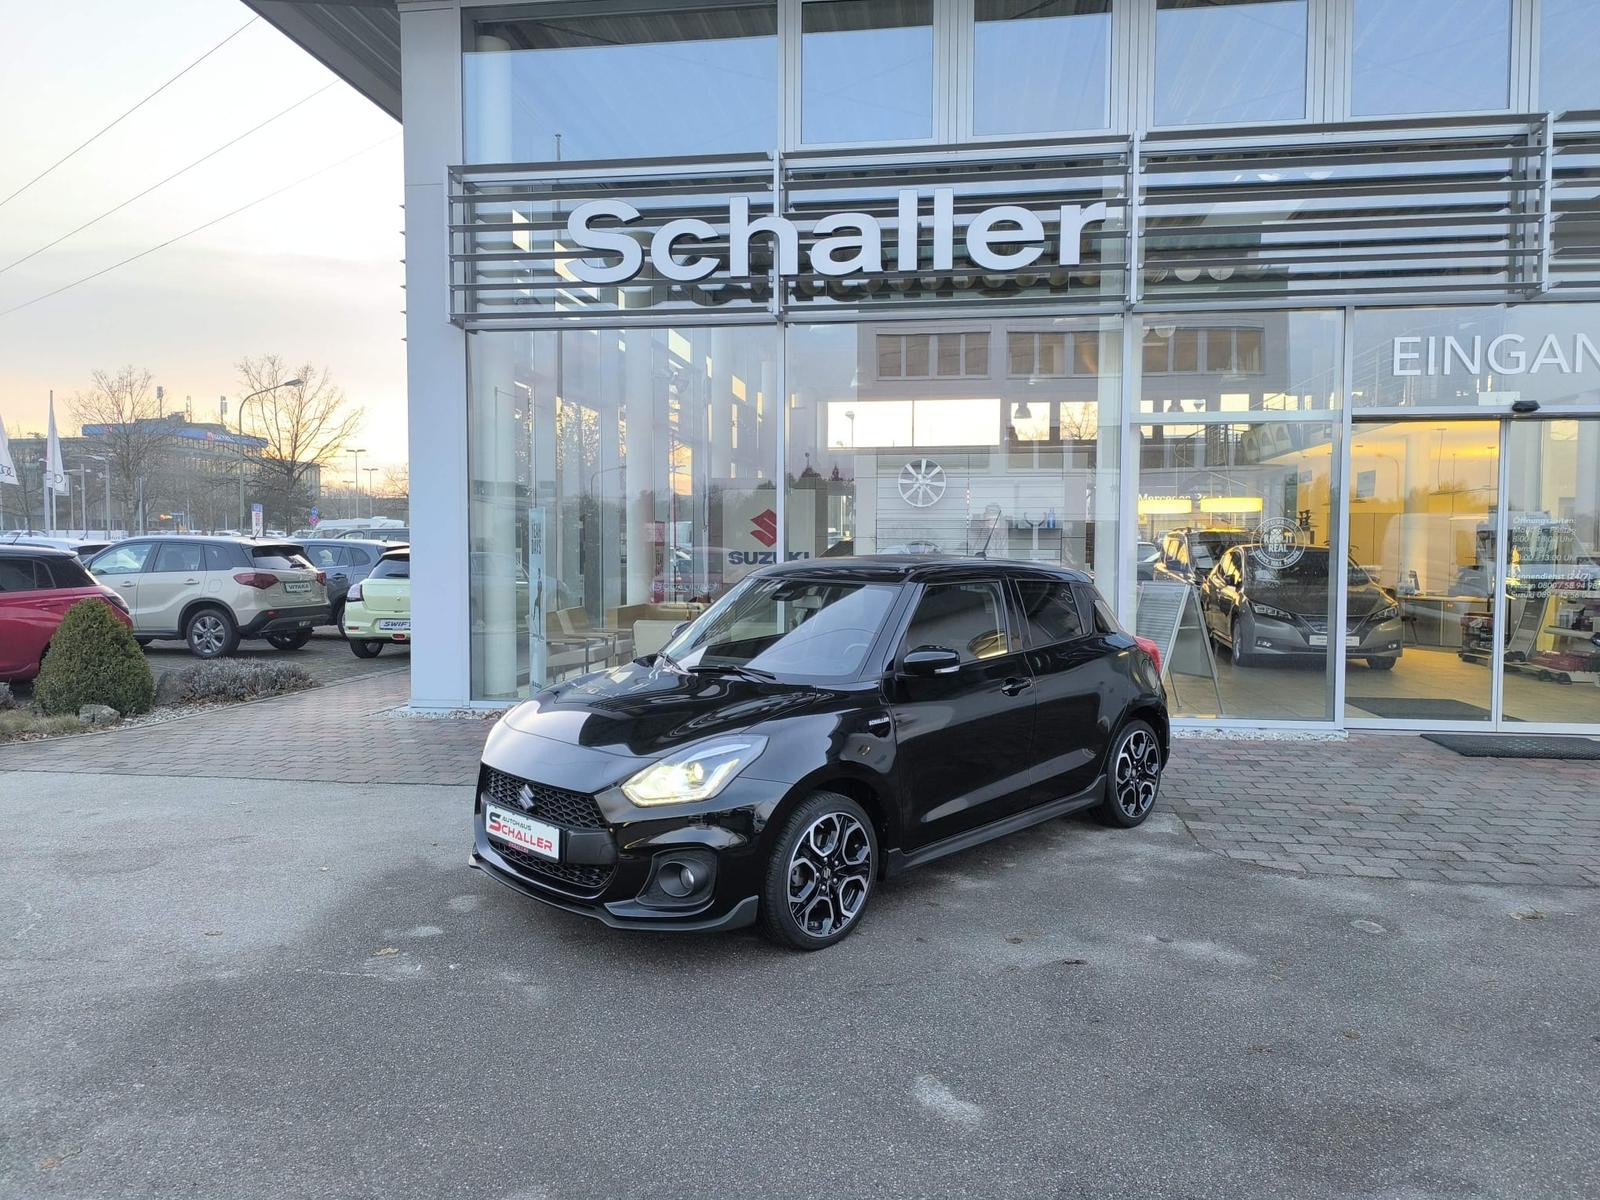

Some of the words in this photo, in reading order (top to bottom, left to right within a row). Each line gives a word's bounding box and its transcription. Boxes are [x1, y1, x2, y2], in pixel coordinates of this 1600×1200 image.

[566, 188, 1107, 284] Schaller
[1393, 333, 1600, 376] EINGAN
[728, 551, 810, 565] SUZKI
[502, 815, 532, 831] AUTOHAUS
